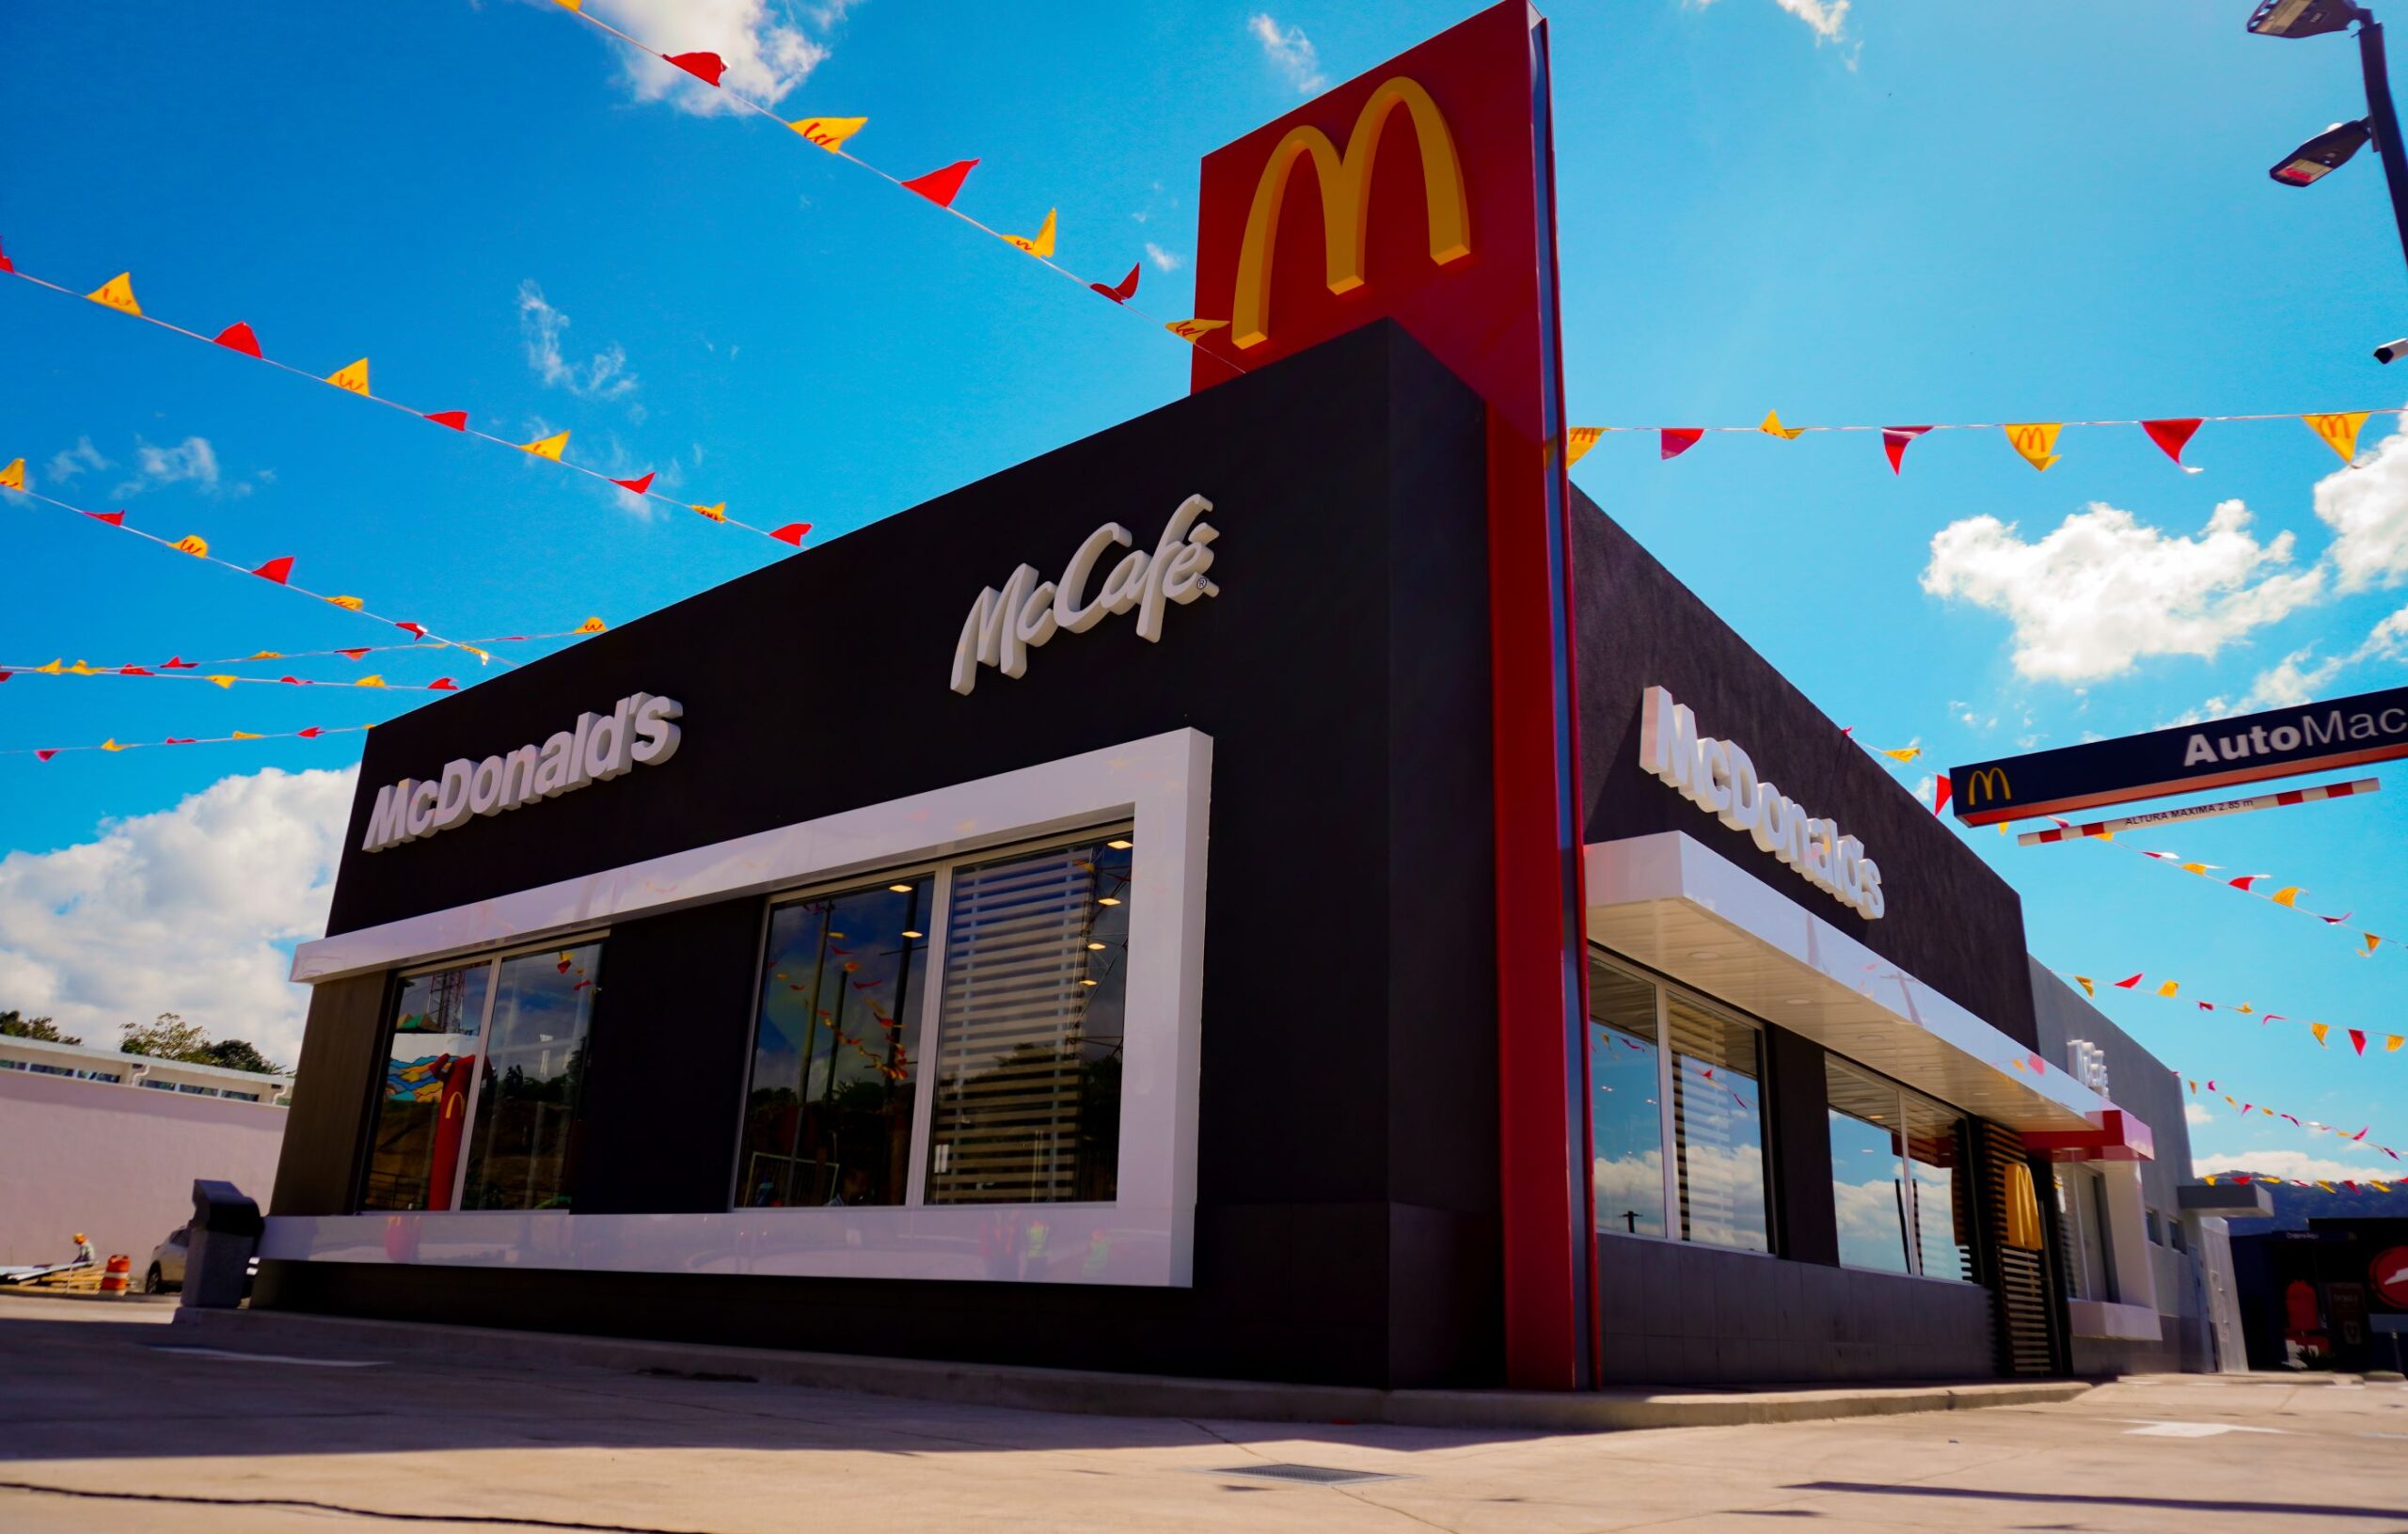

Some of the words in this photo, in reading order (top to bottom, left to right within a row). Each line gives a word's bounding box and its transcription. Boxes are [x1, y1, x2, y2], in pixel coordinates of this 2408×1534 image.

[950, 493, 1220, 696] McCafé
[362, 691, 684, 852] McDonald's
[2183, 707, 2408, 767] AutoMac
[2124, 812, 2169, 826] ALTURA
[2171, 803, 2216, 817] MAXIMA
